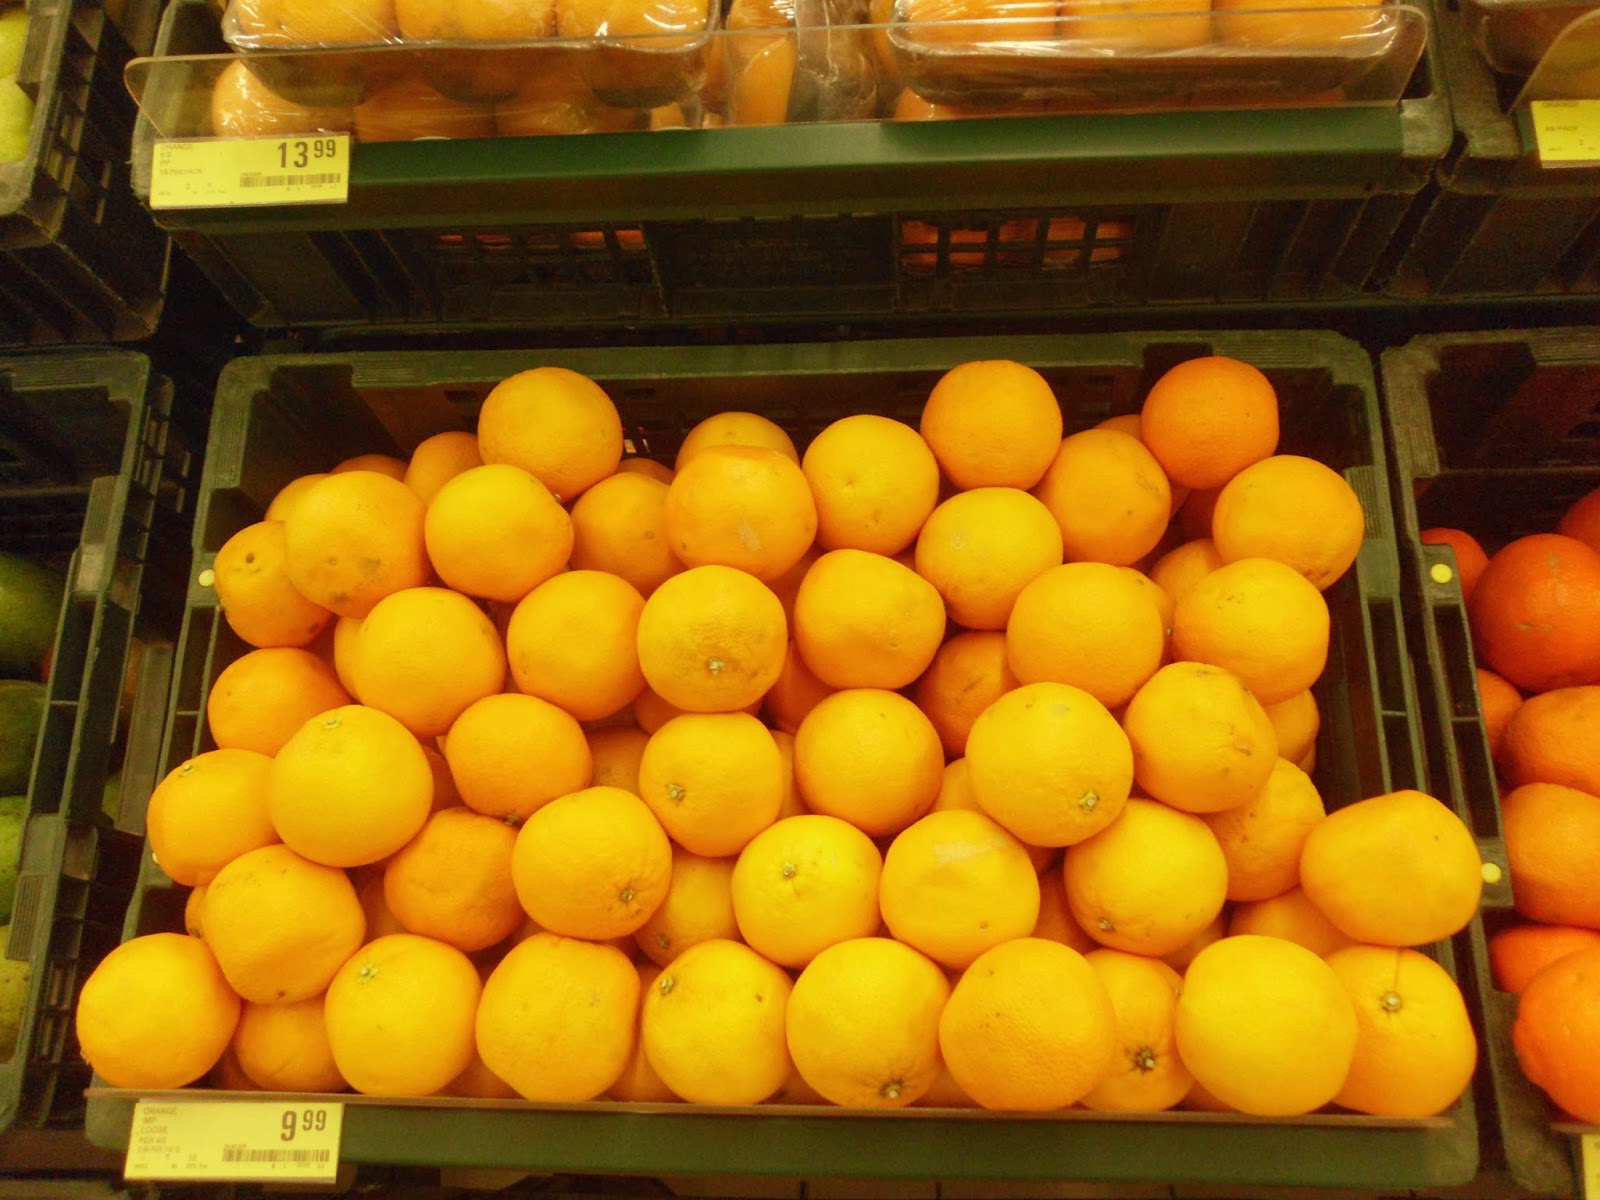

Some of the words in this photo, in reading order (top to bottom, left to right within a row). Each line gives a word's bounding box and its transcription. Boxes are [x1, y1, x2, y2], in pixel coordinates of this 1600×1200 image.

[277, 141, 308, 168] 13
[313, 139, 337, 158] 99
[143, 1107, 178, 1115] ORANGE
[280, 1110, 298, 1142] 9
[302, 1109, 327, 1131] 99
